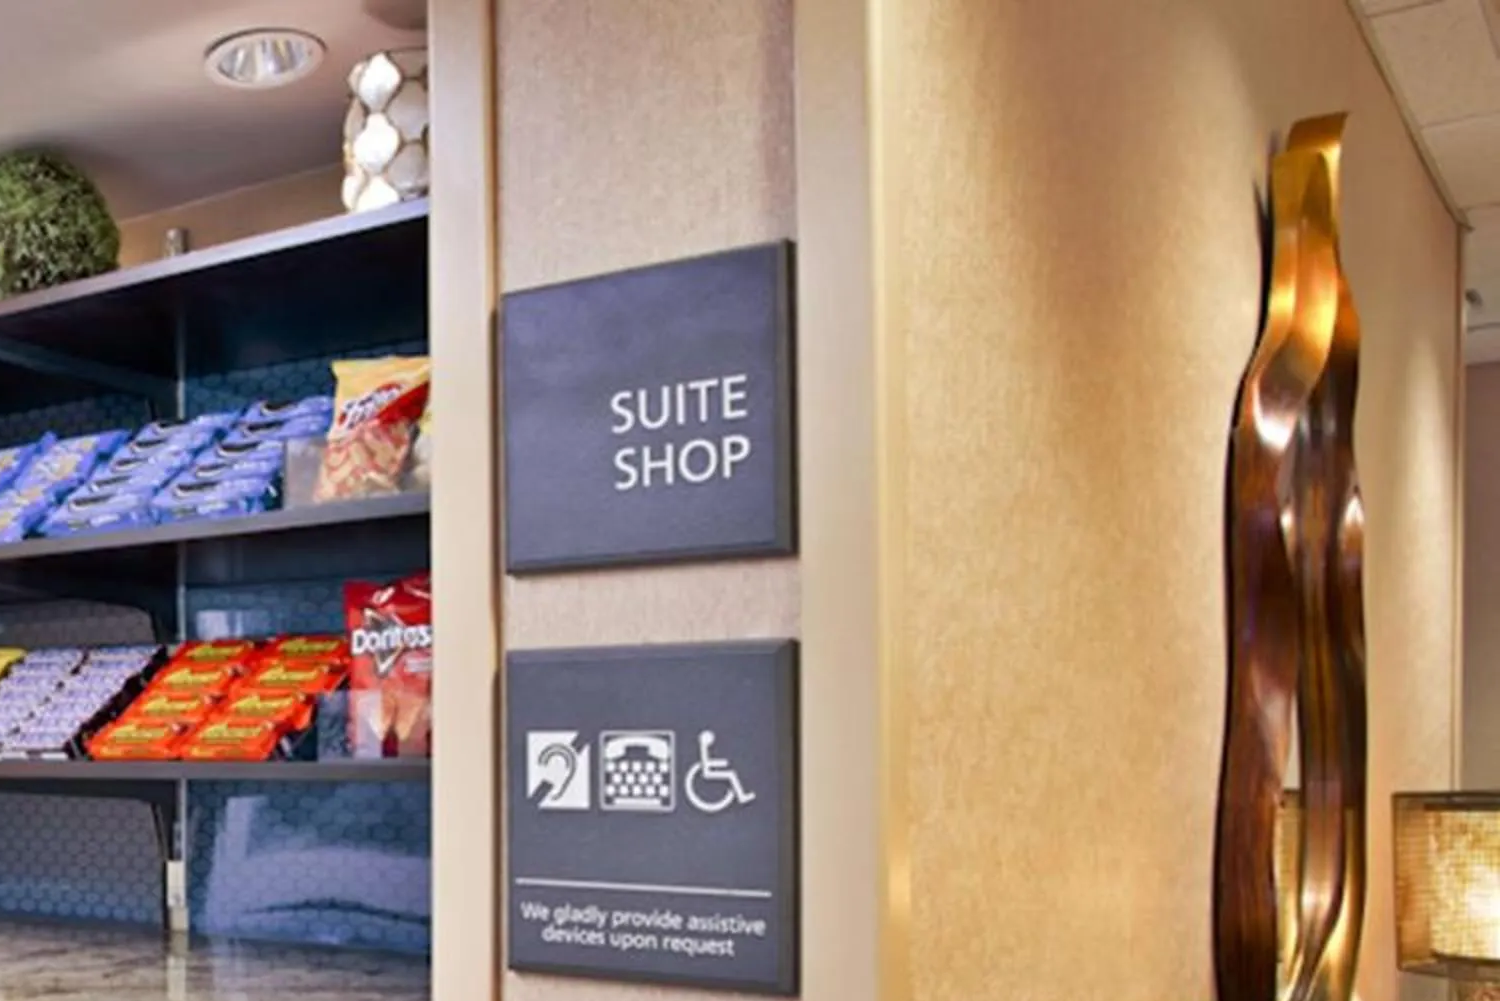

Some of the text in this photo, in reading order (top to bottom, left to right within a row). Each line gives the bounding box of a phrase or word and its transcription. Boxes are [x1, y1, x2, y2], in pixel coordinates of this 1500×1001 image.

[609, 374, 748, 434] SUITE
[613, 434, 751, 491] SHOP
[350, 625, 432, 656] Doritos
[520, 901, 767, 935] We gladly provide assistive
[541, 923, 736, 957] devices upon request
